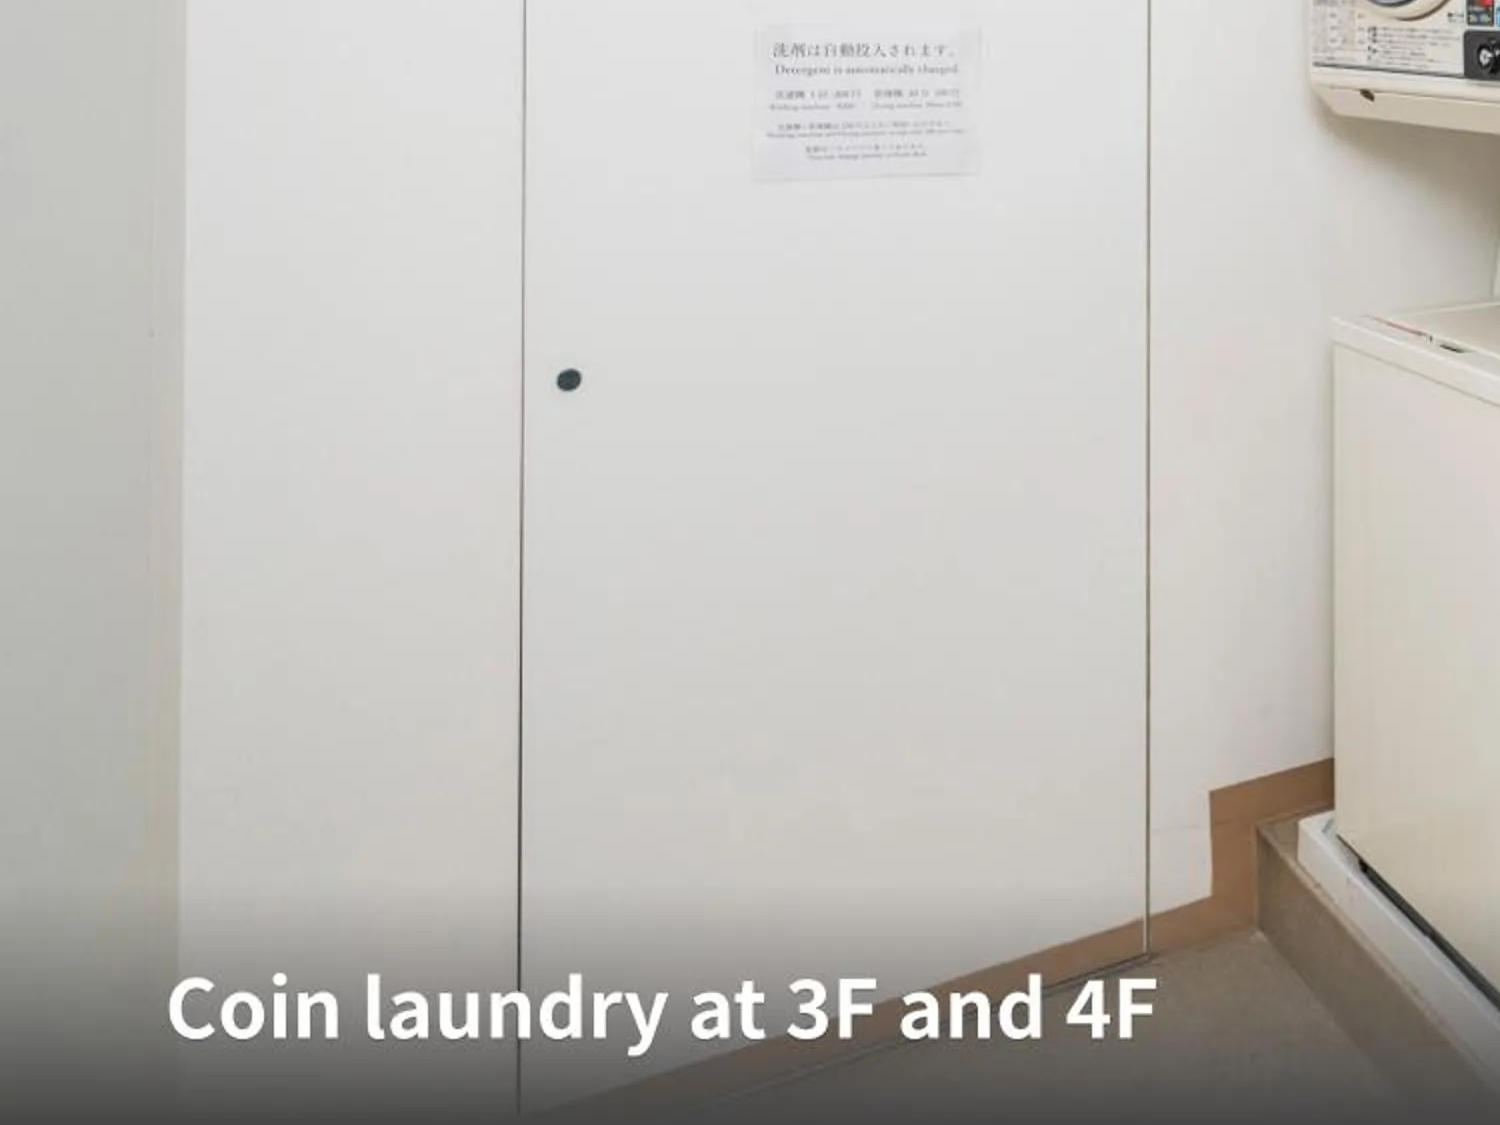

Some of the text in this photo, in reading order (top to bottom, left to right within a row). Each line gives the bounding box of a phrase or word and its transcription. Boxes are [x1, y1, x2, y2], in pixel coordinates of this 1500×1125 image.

[772, 42, 956, 59] 洗剤は自動投入されます。
